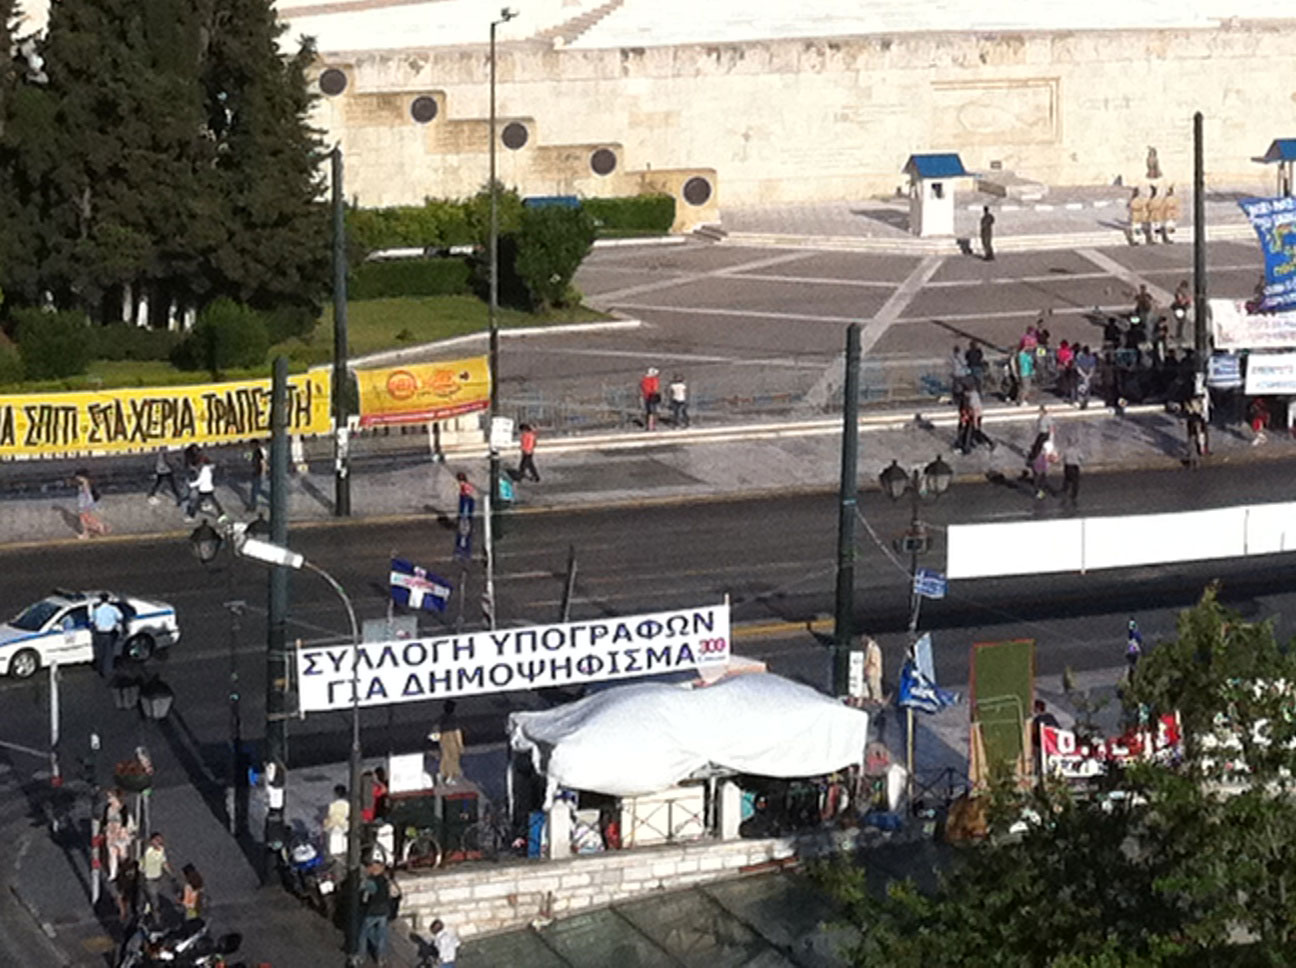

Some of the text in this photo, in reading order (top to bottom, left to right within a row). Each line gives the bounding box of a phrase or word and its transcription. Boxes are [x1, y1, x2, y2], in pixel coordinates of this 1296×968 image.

[24, 404, 78, 446] ΣΠΙΤΙ
[201, 379, 313, 436] ΤΡΑΠΕΤΗ
[302, 610, 715, 675] ΣΥΛΛΟΓΗ ΥΠΟΓΡΑΦΩΝ
[327, 642, 695, 704] ΓΙΑ ΔΗΜΟΨΗΦΙΣΜΑ
